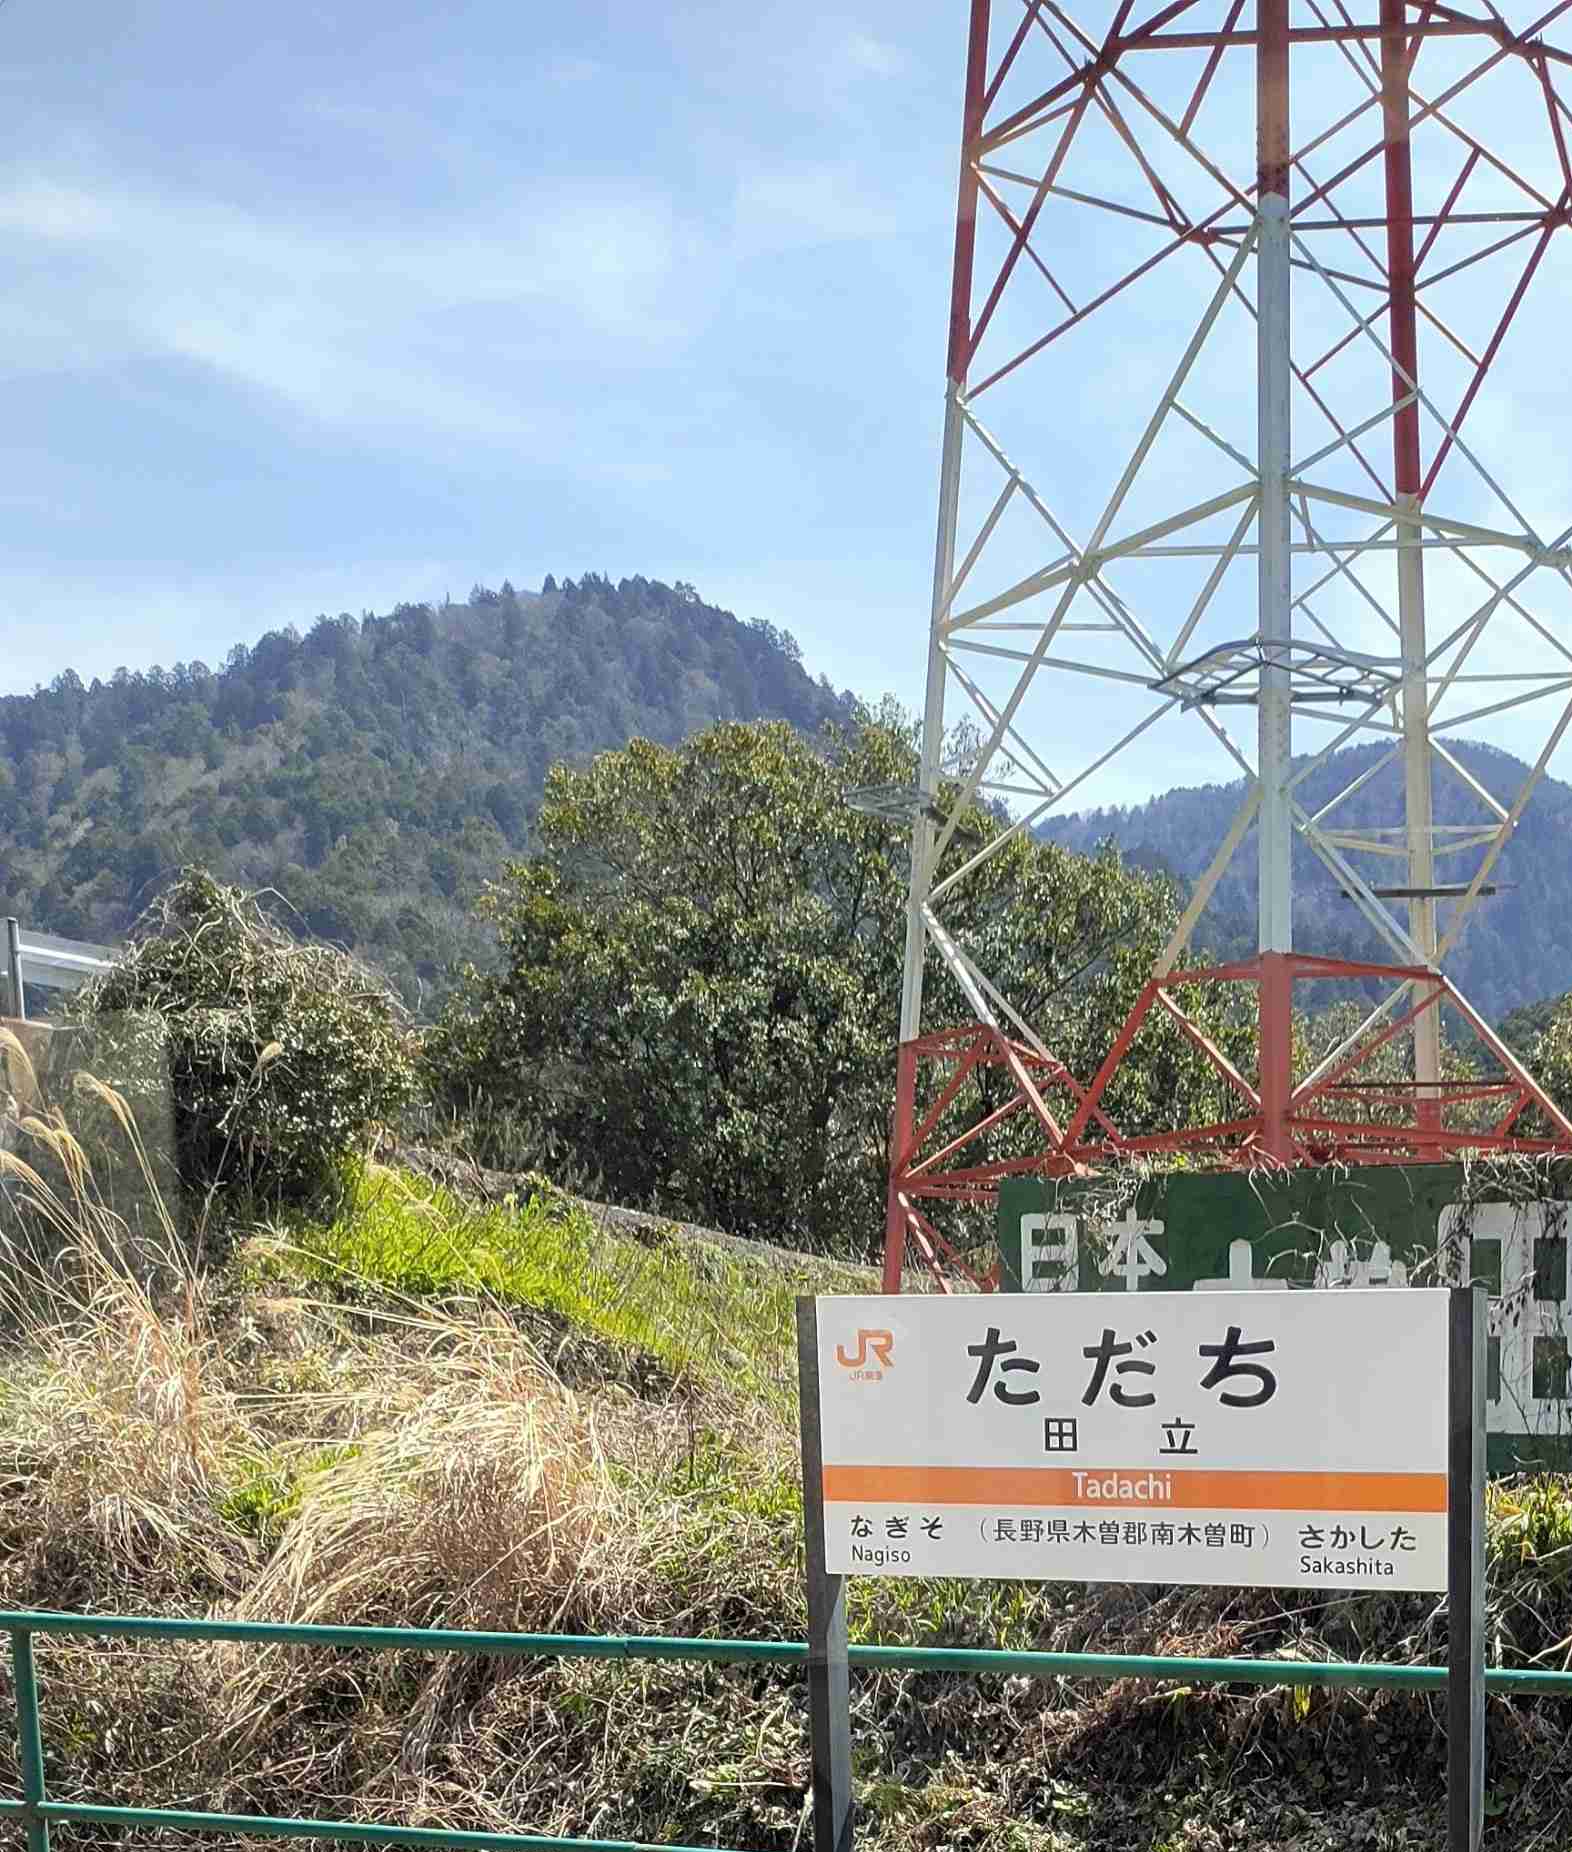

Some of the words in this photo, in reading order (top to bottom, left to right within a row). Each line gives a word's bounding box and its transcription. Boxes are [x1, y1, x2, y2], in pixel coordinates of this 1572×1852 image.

[1020, 1206, 1167, 1291] 日本
[836, 1328, 894, 1369] JR
[966, 1326, 1278, 1407] ただち
[1043, 1417, 1199, 1456] 田立
[1071, 1471, 1171, 1501] Tadachi
[850, 1514, 944, 1541] なぎそ
[1298, 1524, 1417, 1551] さかした
[851, 1544, 911, 1567] Nagiso
[1299, 1556, 1394, 1577] Sakashita
